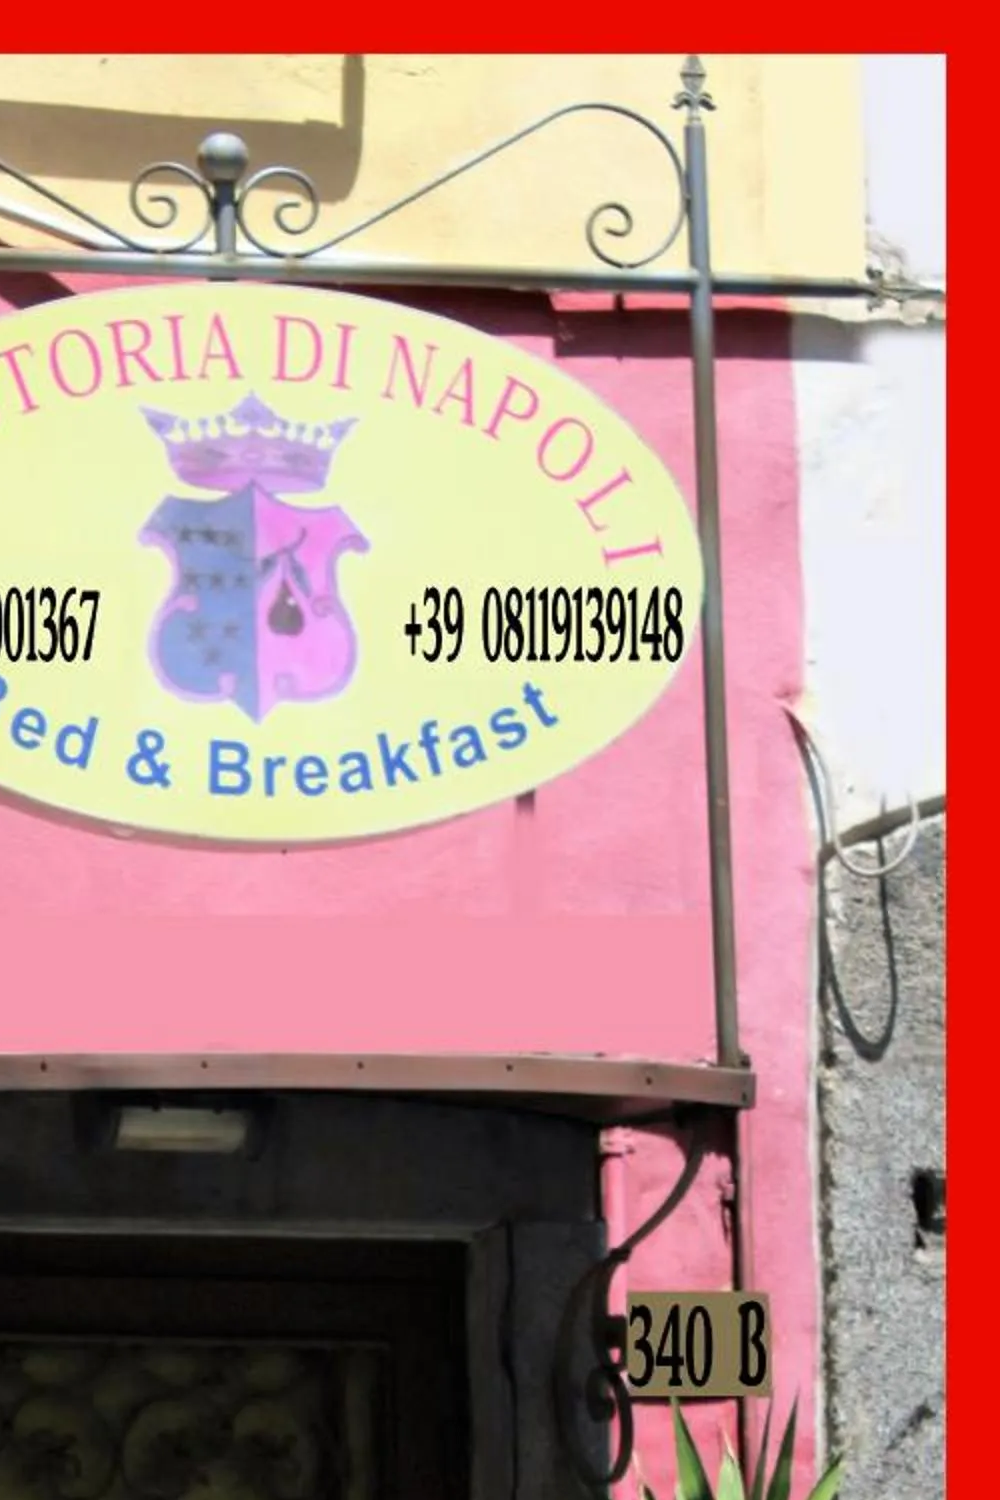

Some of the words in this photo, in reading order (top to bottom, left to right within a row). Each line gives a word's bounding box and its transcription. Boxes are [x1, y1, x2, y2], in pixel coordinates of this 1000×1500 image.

[273, 315, 356, 390] DI
[382, 334, 664, 567] NAPOLI
[126, 730, 172, 788] &
[207, 679, 559, 798] Breakfast
